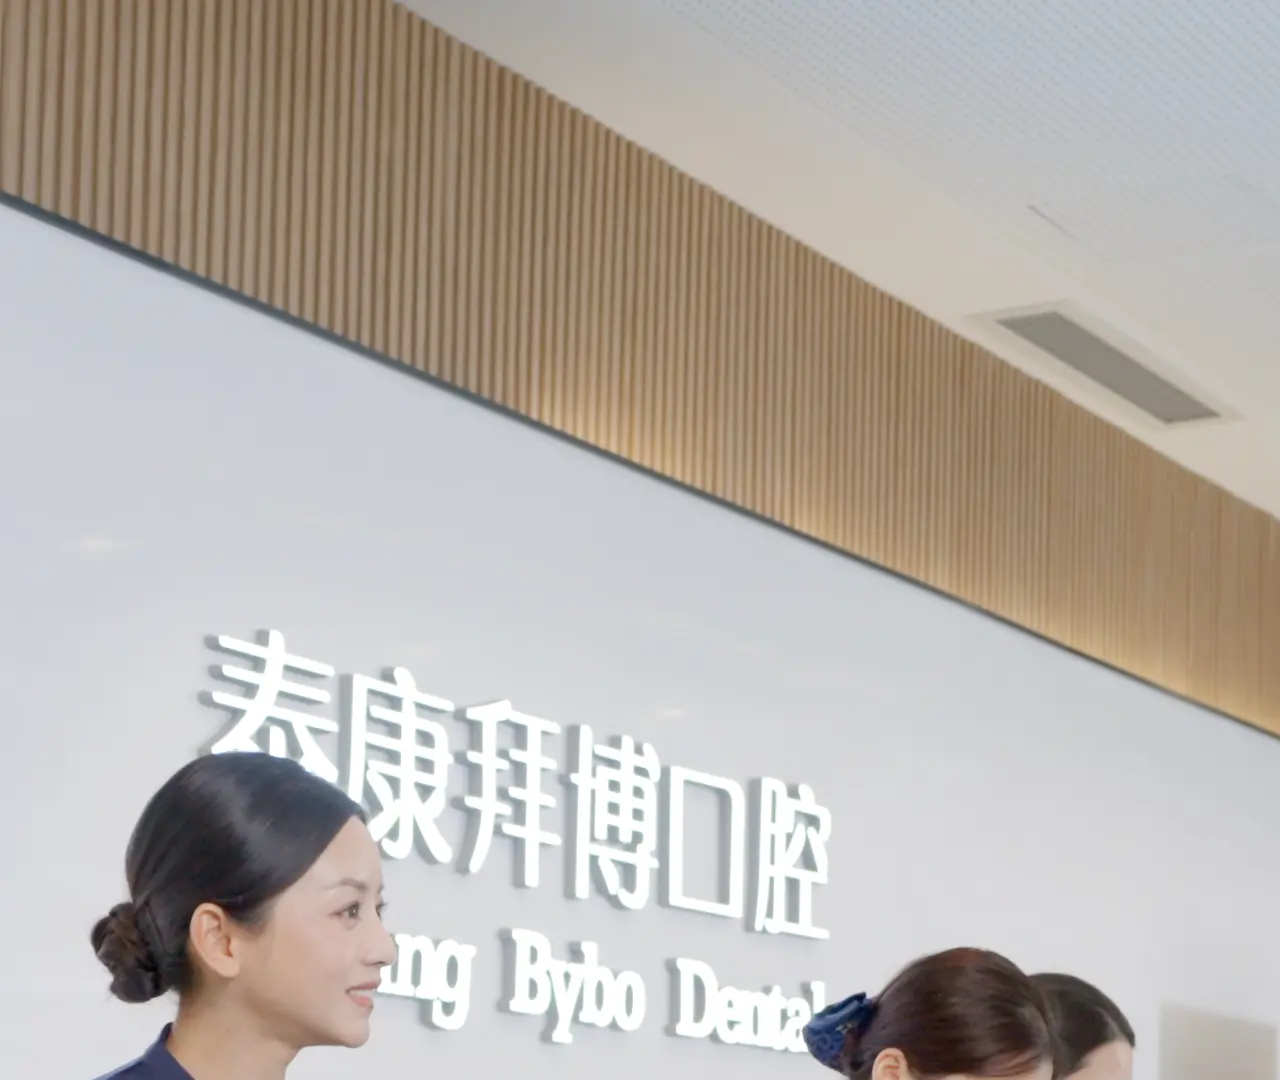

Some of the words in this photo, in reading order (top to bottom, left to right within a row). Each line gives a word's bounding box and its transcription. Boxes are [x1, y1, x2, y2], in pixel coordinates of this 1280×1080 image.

[212, 630, 832, 939] 泰康拜博口腔
[509, 928, 646, 1043] Bybo
